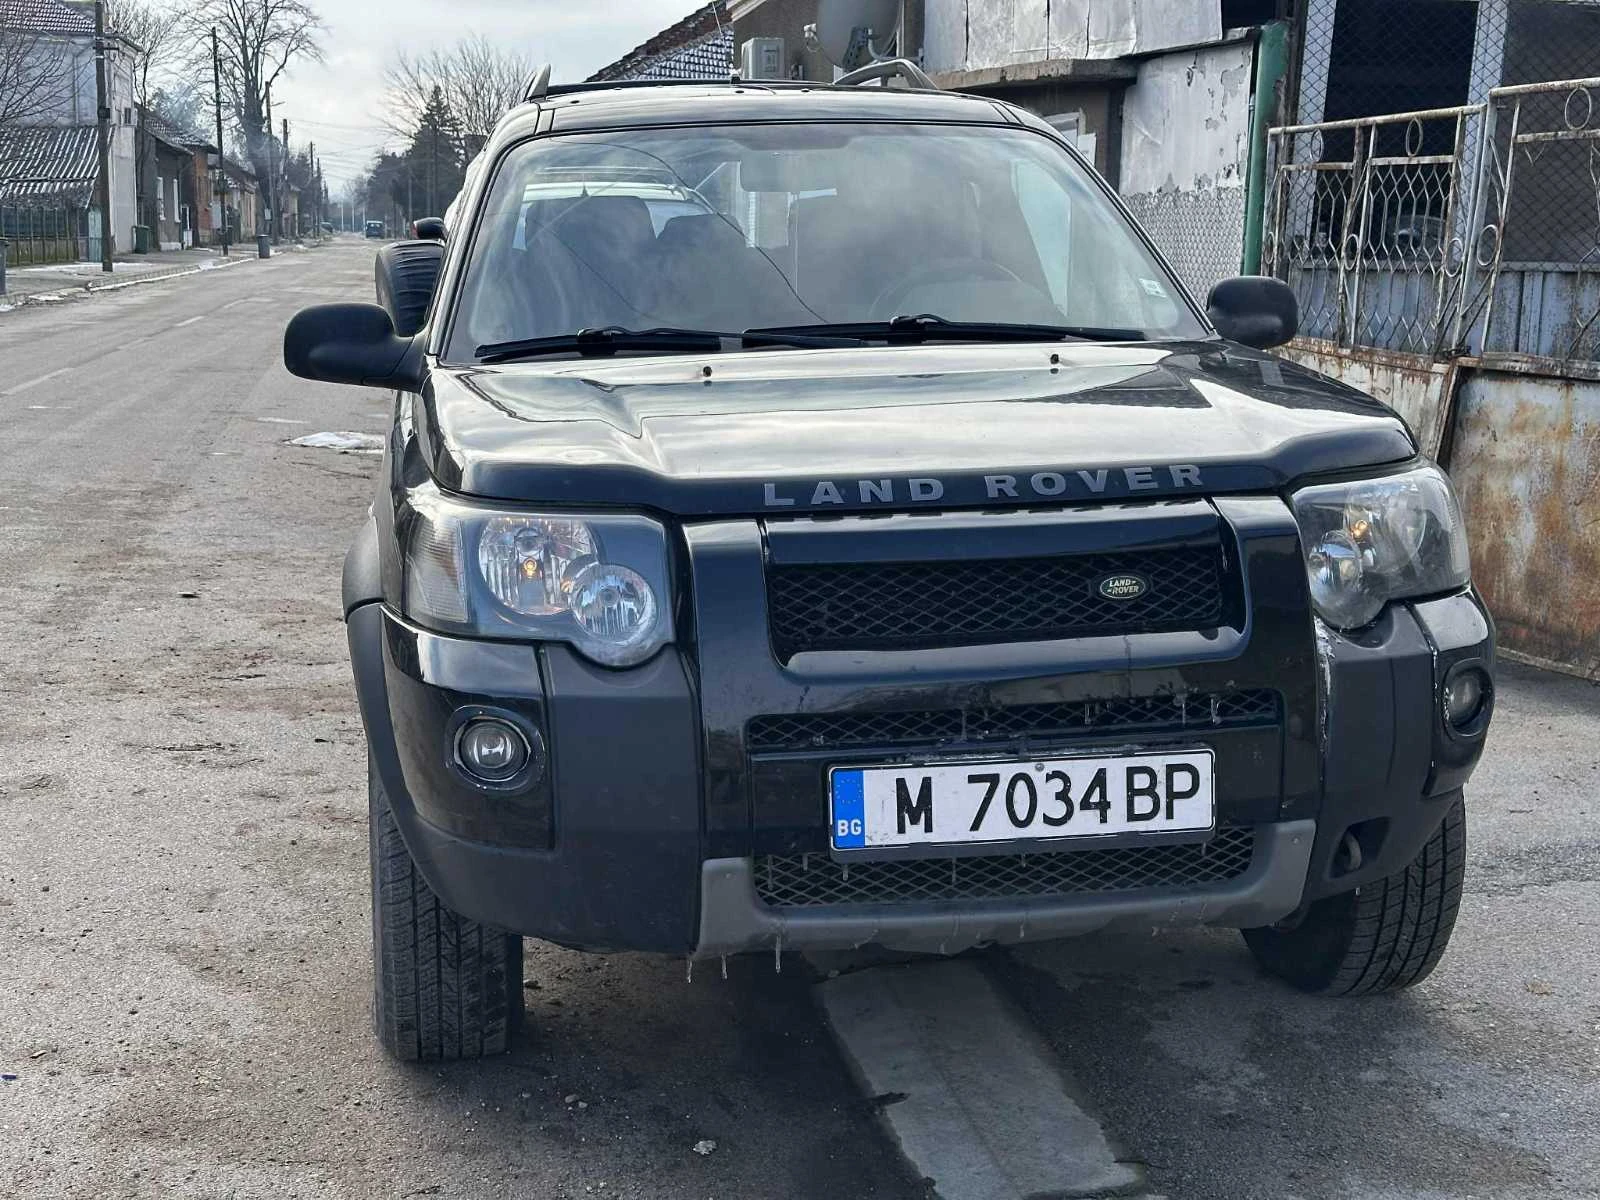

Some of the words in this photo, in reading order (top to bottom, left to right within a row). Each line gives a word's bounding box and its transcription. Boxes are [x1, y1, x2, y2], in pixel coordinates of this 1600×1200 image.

[764, 478, 945, 506] LAND
[984, 464, 1204, 499] ROVER
[895, 776, 934, 834] M
[837, 819, 863, 837] BG
